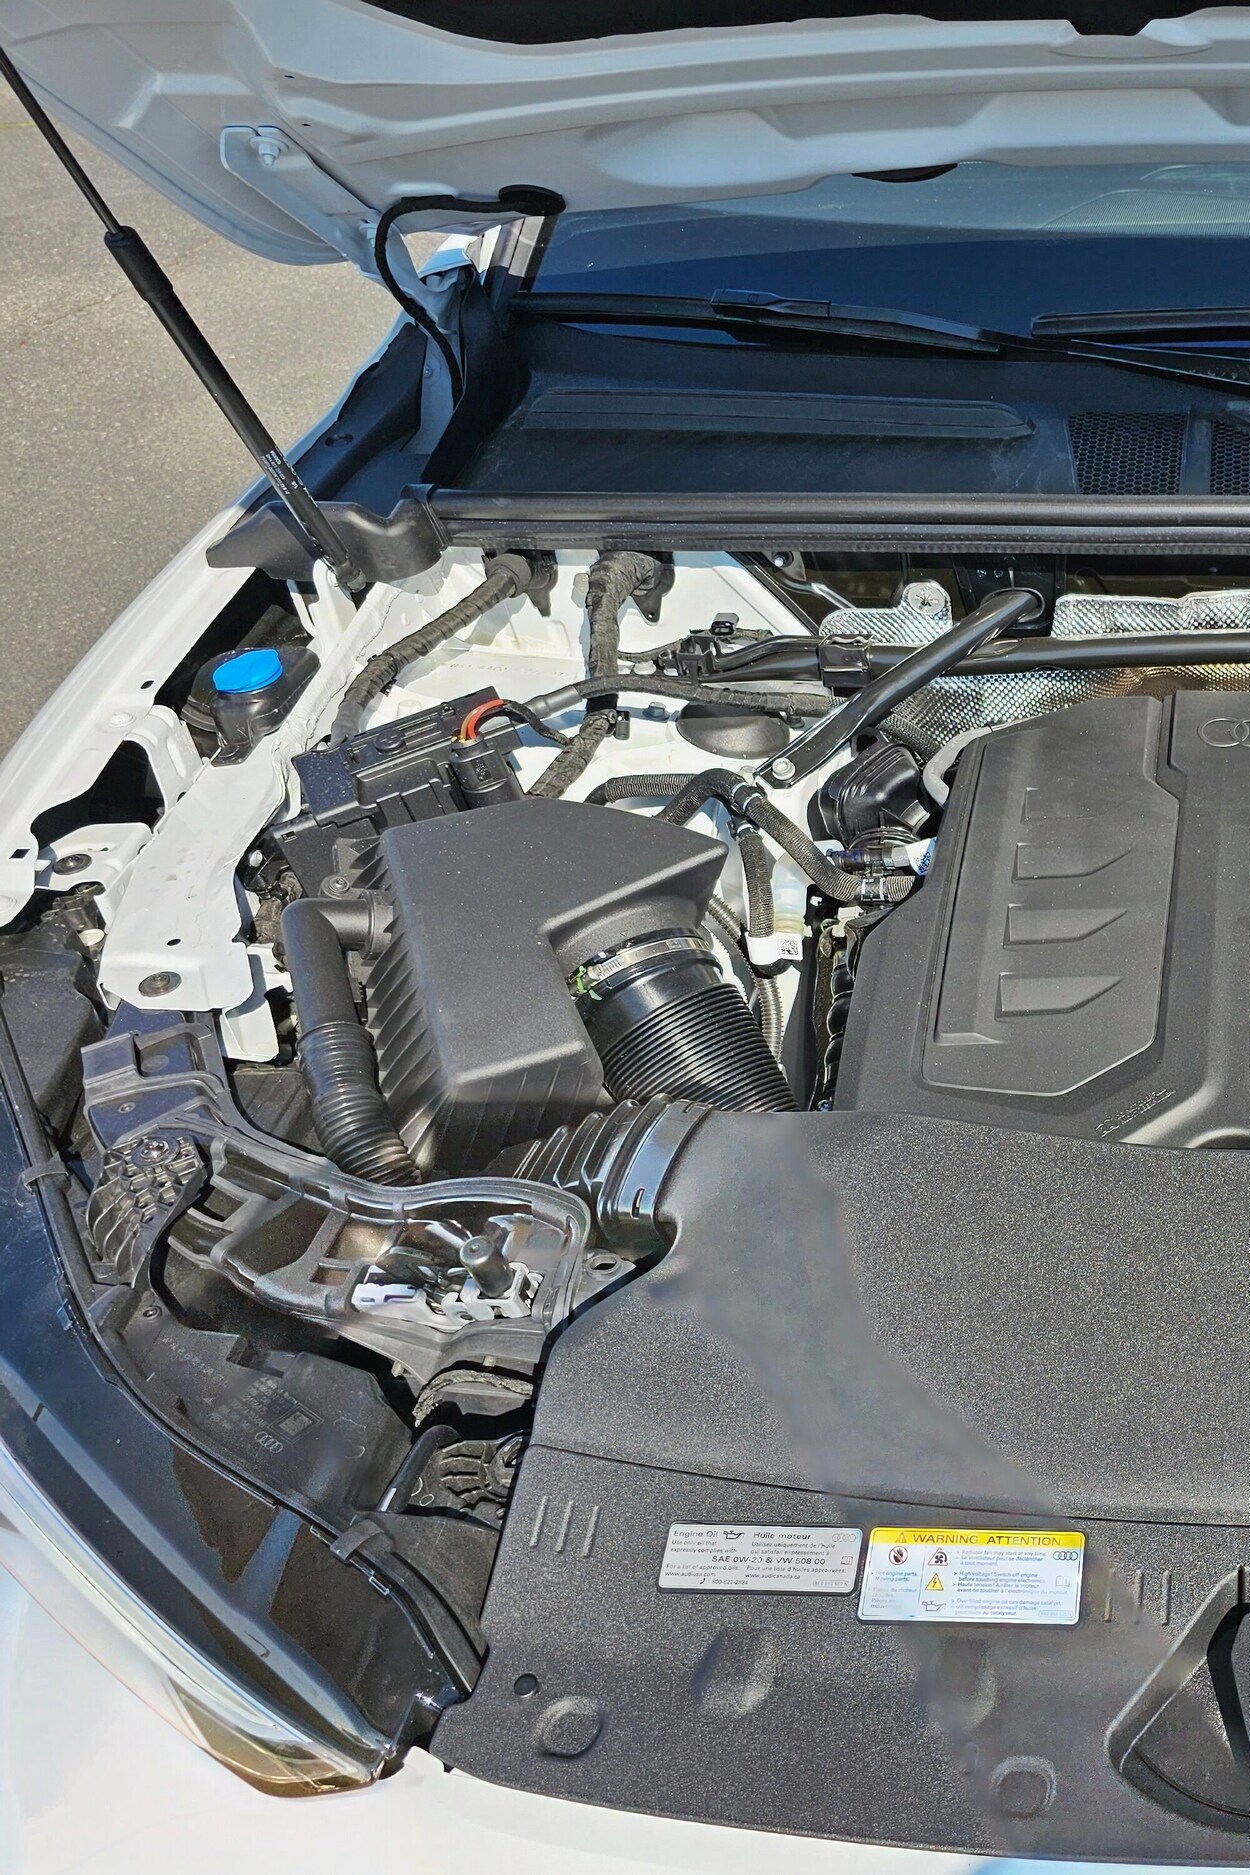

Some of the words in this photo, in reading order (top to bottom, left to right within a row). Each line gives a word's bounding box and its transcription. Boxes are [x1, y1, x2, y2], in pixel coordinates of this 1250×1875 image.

[674, 1530, 703, 1538] Engine
[706, 1530, 719, 1538] Oil
[913, 1533, 978, 1544] WARNING
[986, 1534, 1061, 1546] ATTENTION
[711, 1555, 731, 1563] SAE
